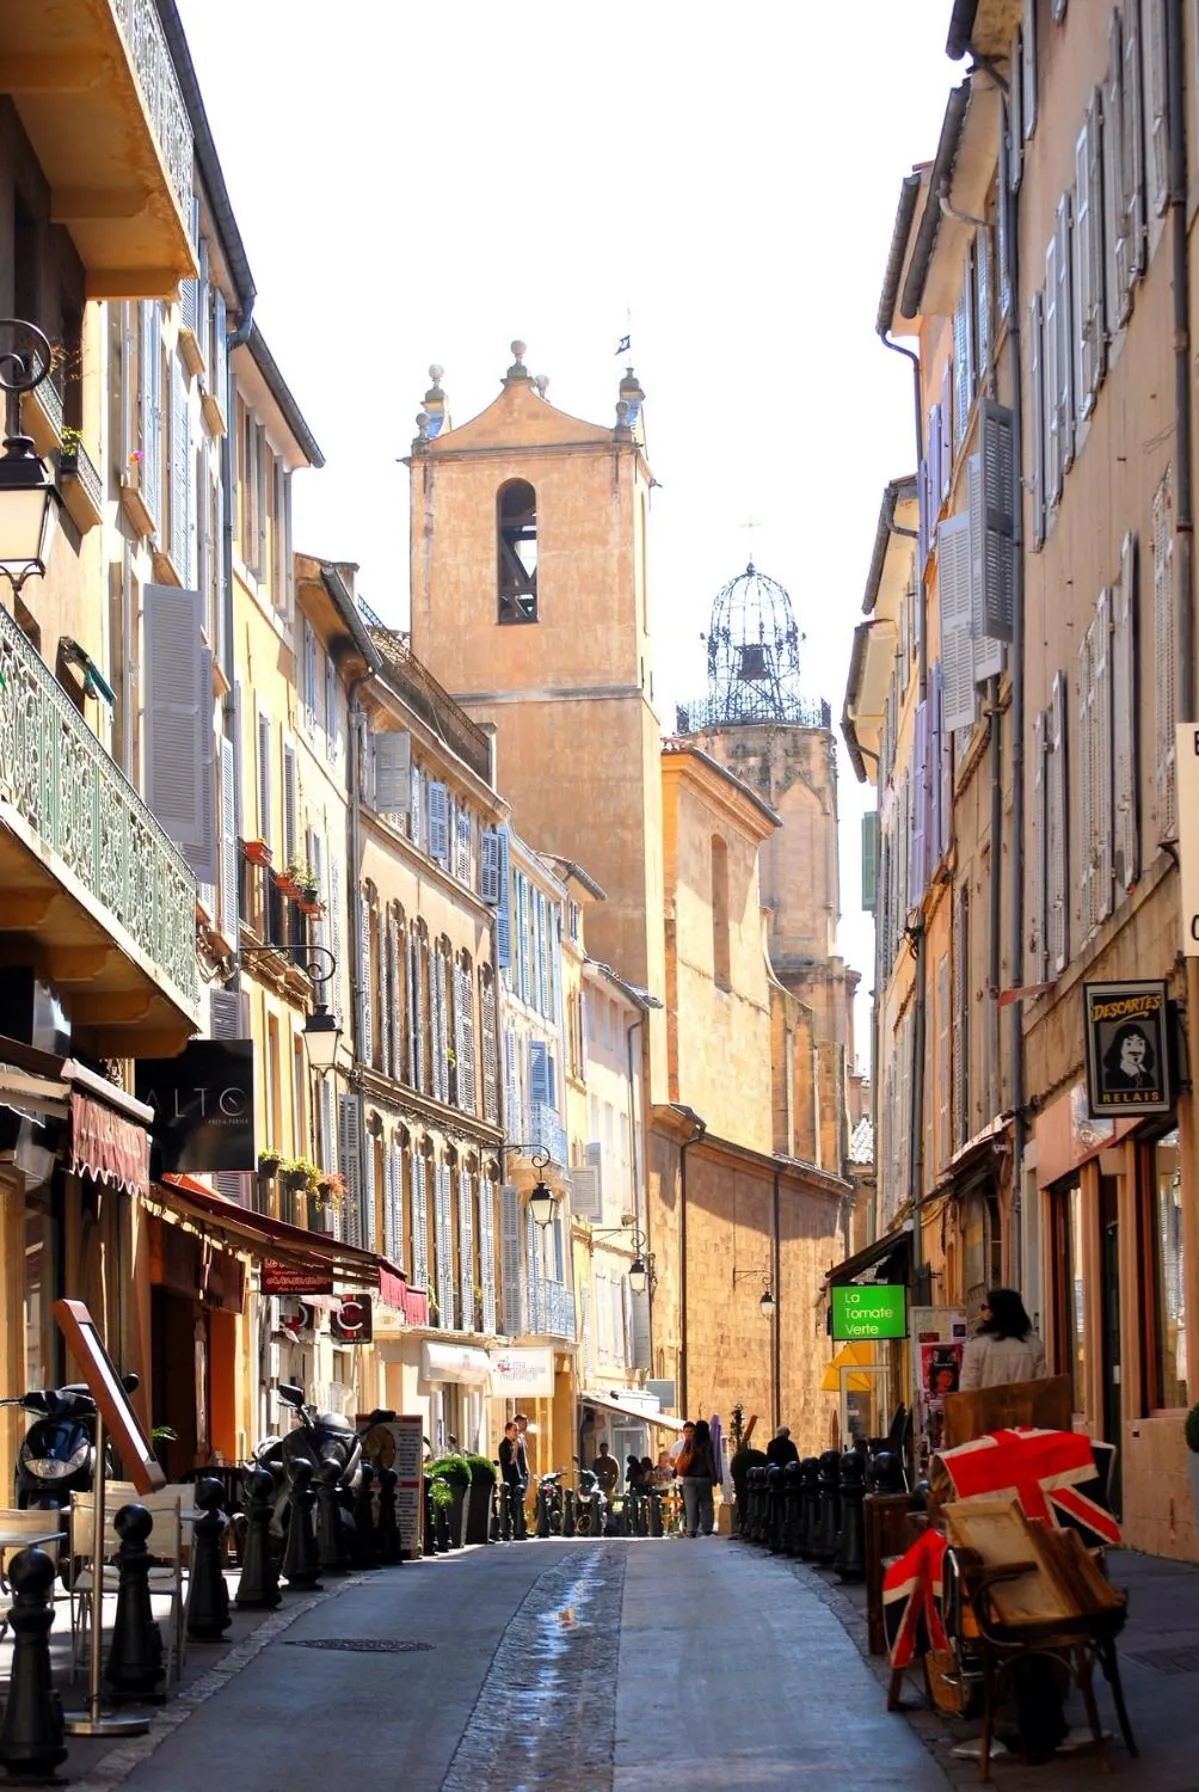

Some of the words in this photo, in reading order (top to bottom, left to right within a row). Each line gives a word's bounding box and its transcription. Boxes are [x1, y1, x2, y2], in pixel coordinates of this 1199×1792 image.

[1091, 995, 1160, 1021] DESCARTES
[1103, 1092, 1160, 1103] RELAIS
[844, 1292, 860, 1303] La
[845, 1307, 893, 1319] Tomate
[844, 1324, 879, 1336] Verte
